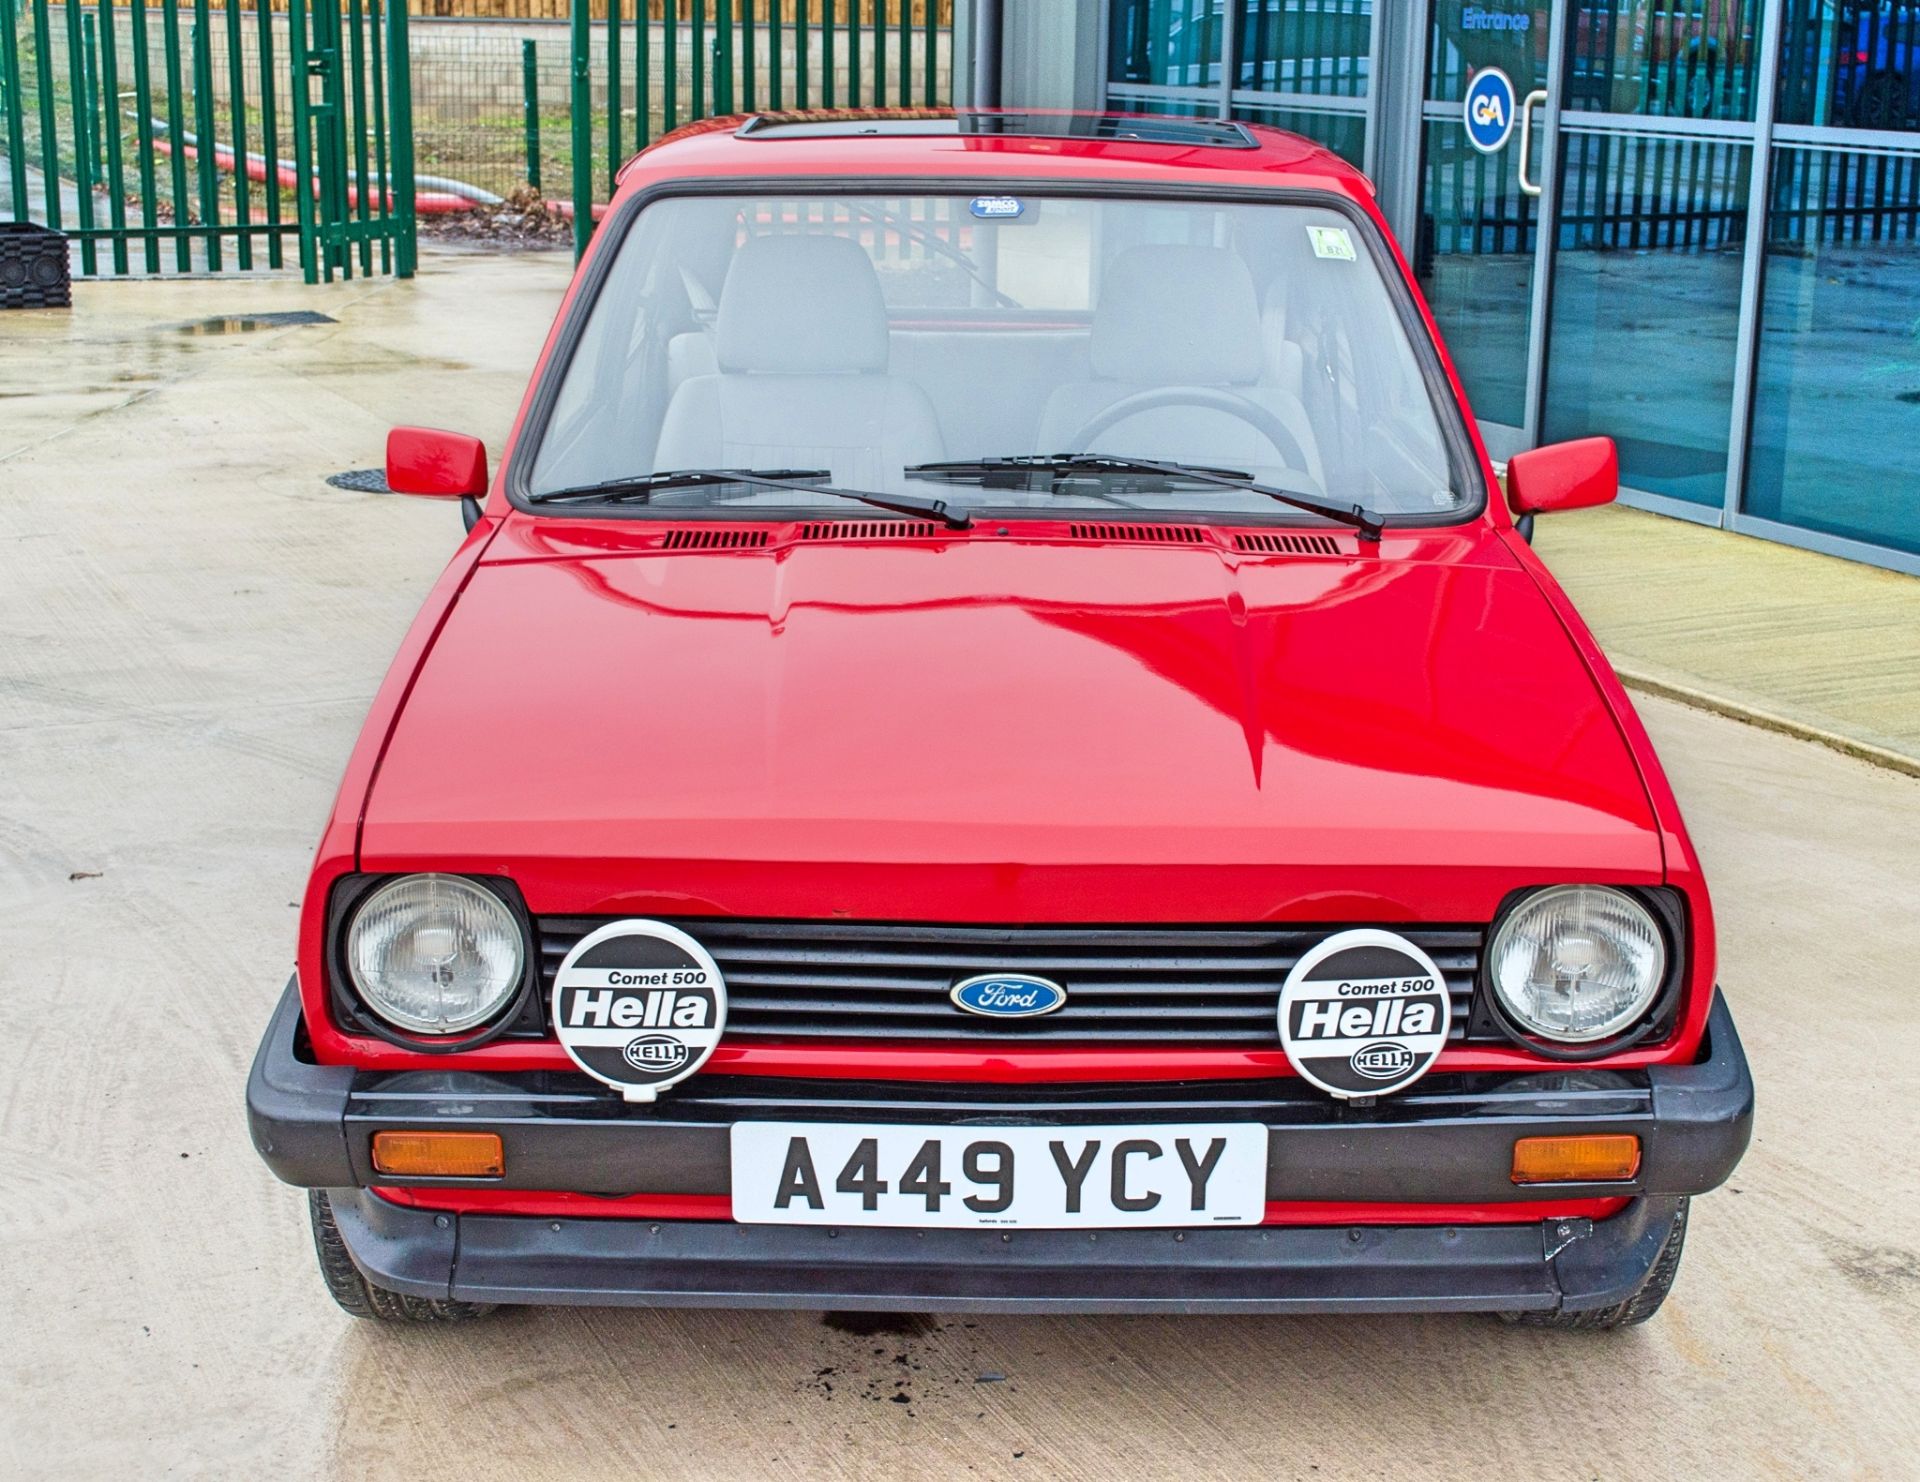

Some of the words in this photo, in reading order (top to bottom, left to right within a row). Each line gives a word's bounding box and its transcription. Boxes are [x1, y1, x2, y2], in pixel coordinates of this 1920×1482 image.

[1461, 7, 1530, 30] Entrance
[1472, 95, 1504, 126] GA
[608, 971, 667, 985] Comet
[672, 972, 707, 985] 500
[1337, 981, 1397, 996] Comet
[1400, 979, 1435, 993] 500
[978, 982, 1038, 1007] Ford
[569, 989, 709, 1027] Hella
[1297, 998, 1436, 1038] Hella
[629, 1044, 686, 1061] HELLA
[1356, 1050, 1413, 1067] HELLA
[772, 1136, 1016, 1213] A449
[1048, 1137, 1228, 1213] YCY
